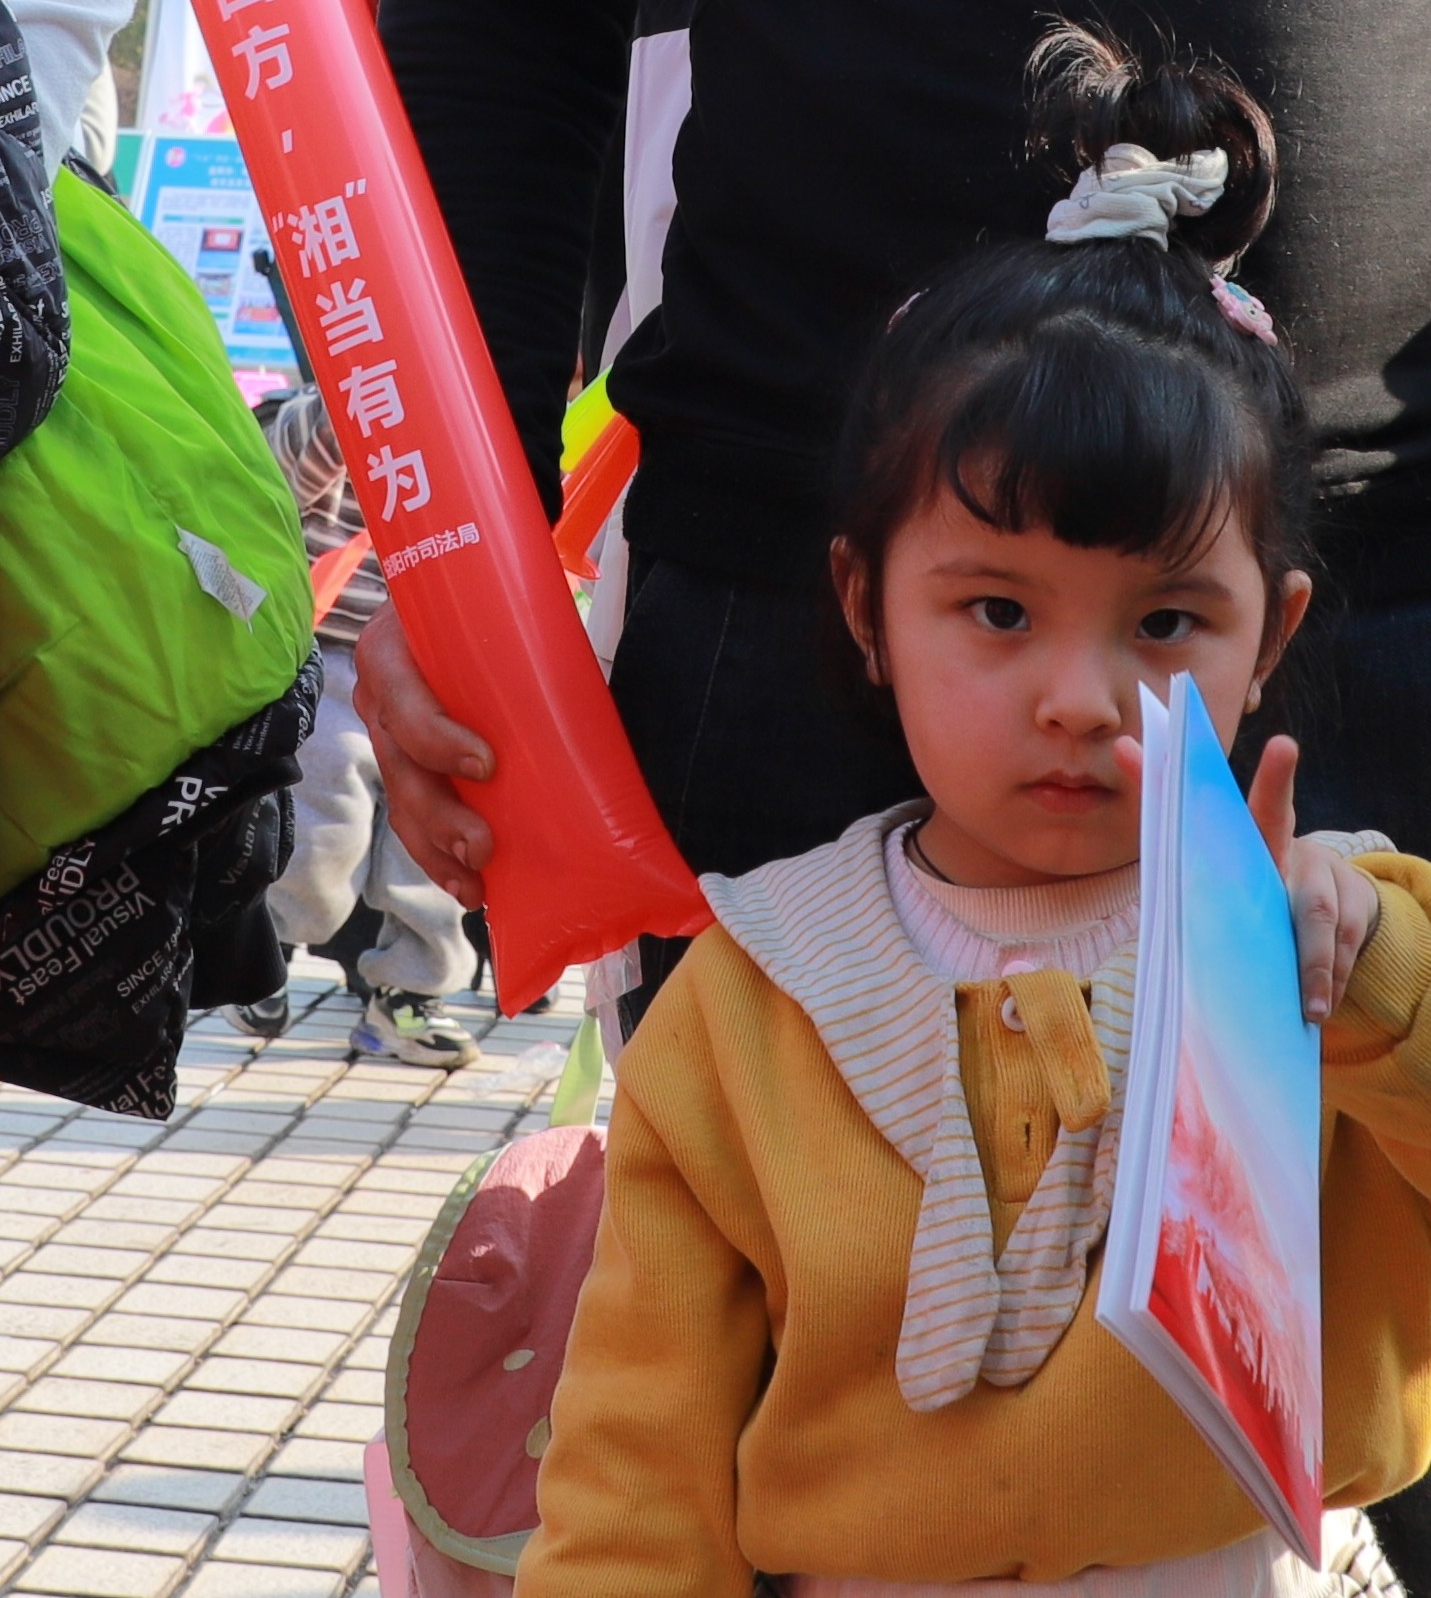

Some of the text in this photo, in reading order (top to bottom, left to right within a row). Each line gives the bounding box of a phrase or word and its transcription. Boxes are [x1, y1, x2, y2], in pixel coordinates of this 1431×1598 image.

[8, 891, 156, 1006] Visual Feast
[117, 950, 166, 999] SINCE
